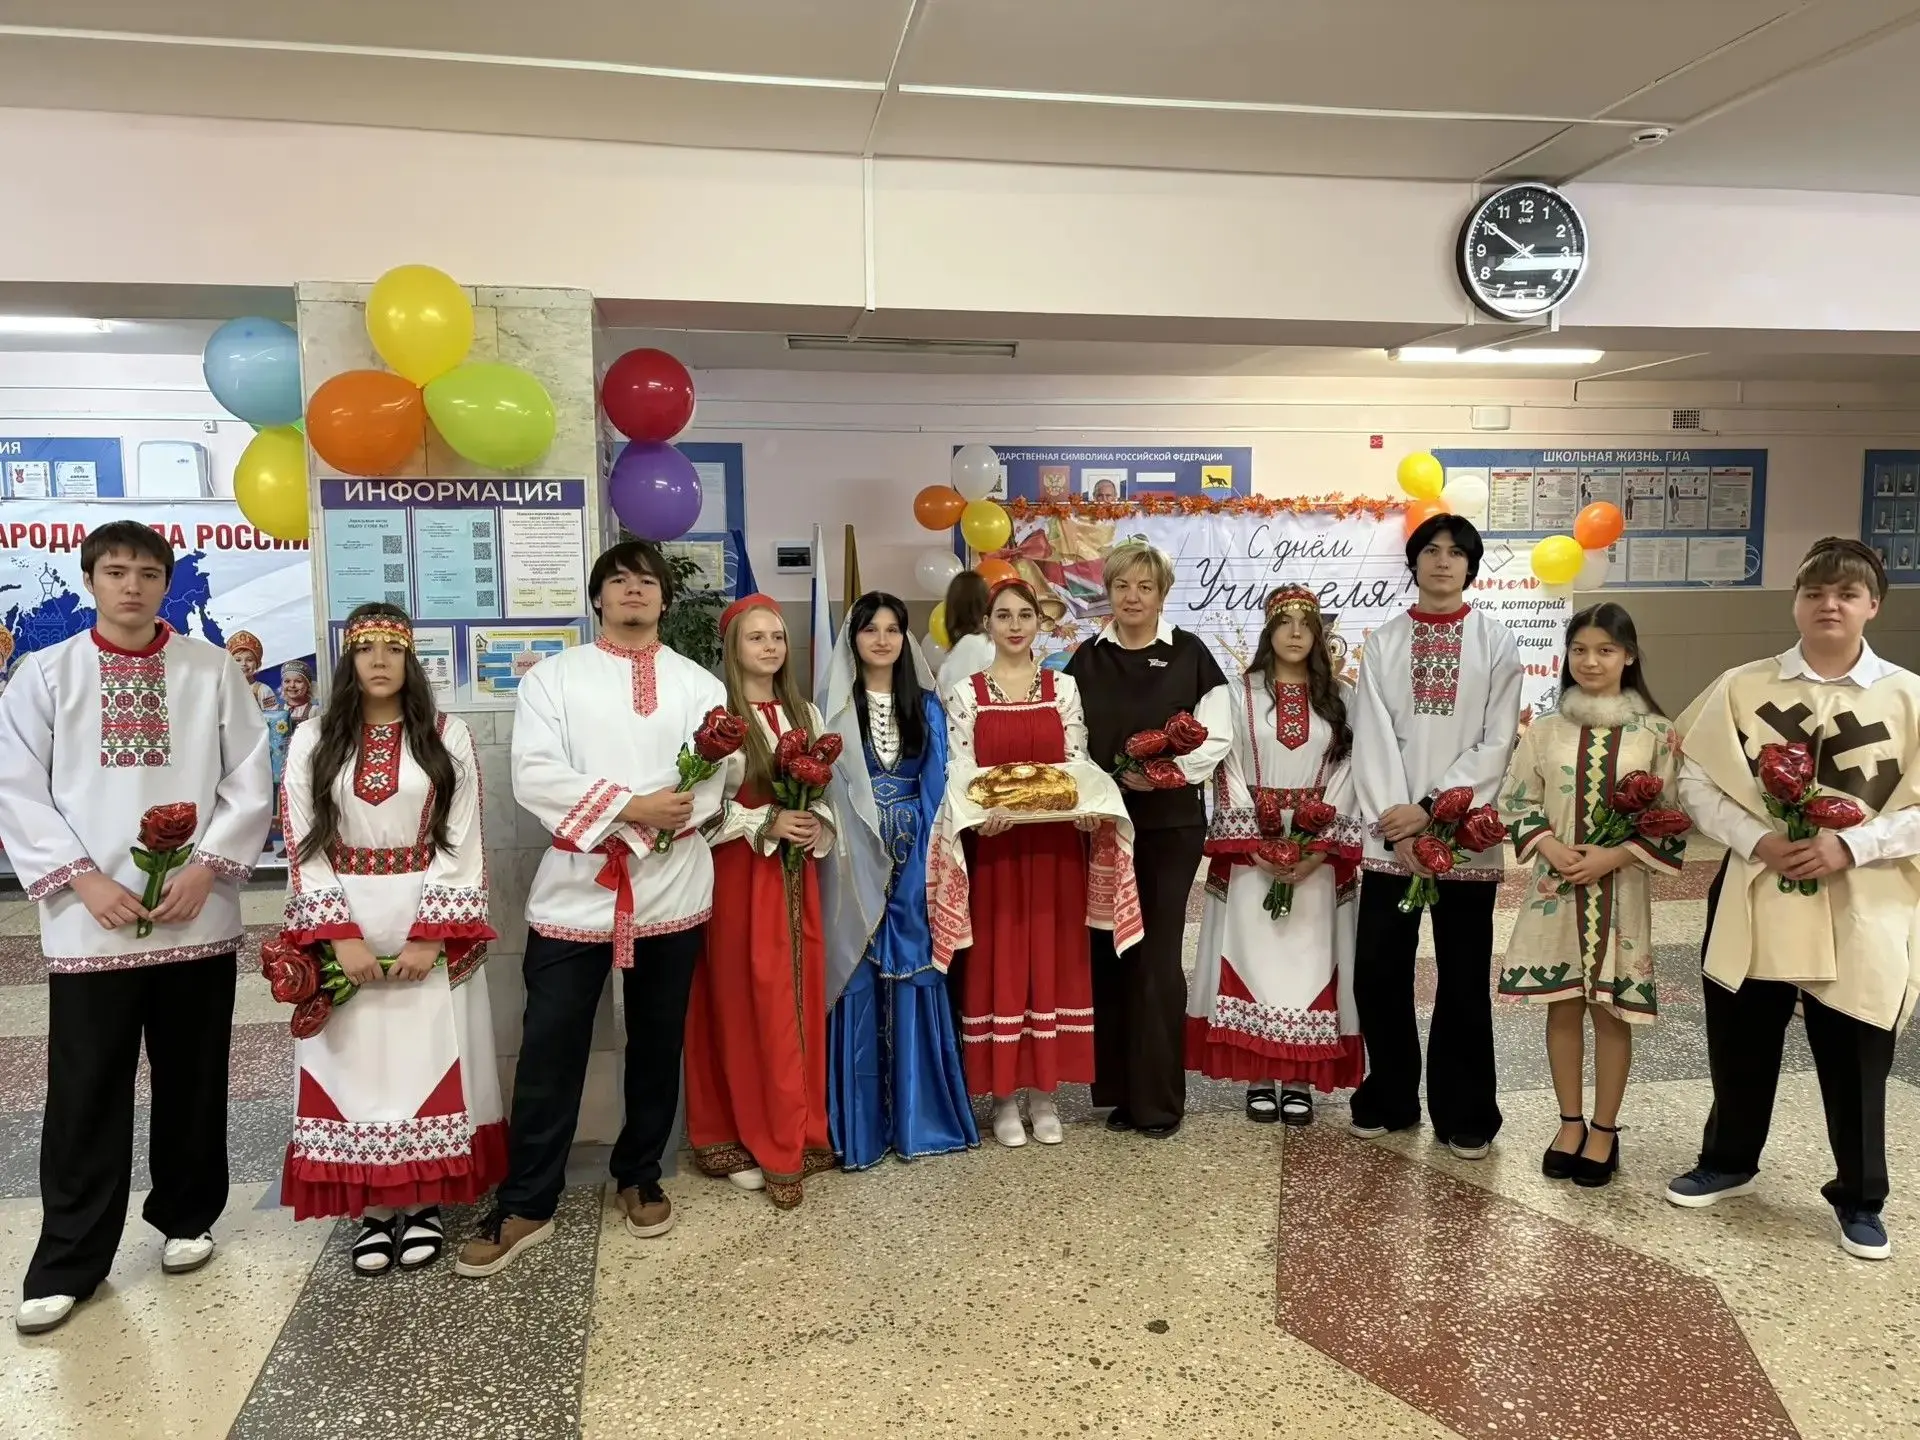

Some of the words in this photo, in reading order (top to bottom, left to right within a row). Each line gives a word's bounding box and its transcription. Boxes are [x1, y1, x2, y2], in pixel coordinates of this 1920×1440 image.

[1497, 205, 1510, 219] 11
[1519, 199, 1534, 213] 12
[1542, 206, 1550, 219] 1
[1482, 223, 1498, 236] 10
[1555, 224, 1566, 238] 2
[1476, 244, 1487, 258] 9
[1560, 246, 1570, 258] 3
[1480, 266, 1491, 280] 8
[1551, 268, 1563, 282] 4
[1496, 283, 1506, 298] 7
[1515, 290, 1526, 302] 6
[1536, 285, 1546, 299] 5
[1060, 452, 1114, 462] СИМВОЛИКА
[1115, 451, 1171, 461] РОССИЙСКОЙ
[1172, 452, 1223, 462] ФЕДЕРАЦИИ
[1543, 451, 1612, 462] ШКОЛЬНАЯ
[1615, 451, 1662, 462] ЖИЗНЬ.
[1665, 451, 1690, 462] ГИА
[344, 481, 563, 505] ИНФОРМАЦИЯ
[1247, 524, 1270, 559] С
[1273, 534, 1354, 572] днём
[1188, 557, 1414, 611] Учиеля!
[1501, 597, 1566, 615] который
[1516, 634, 1553, 650] вещи
